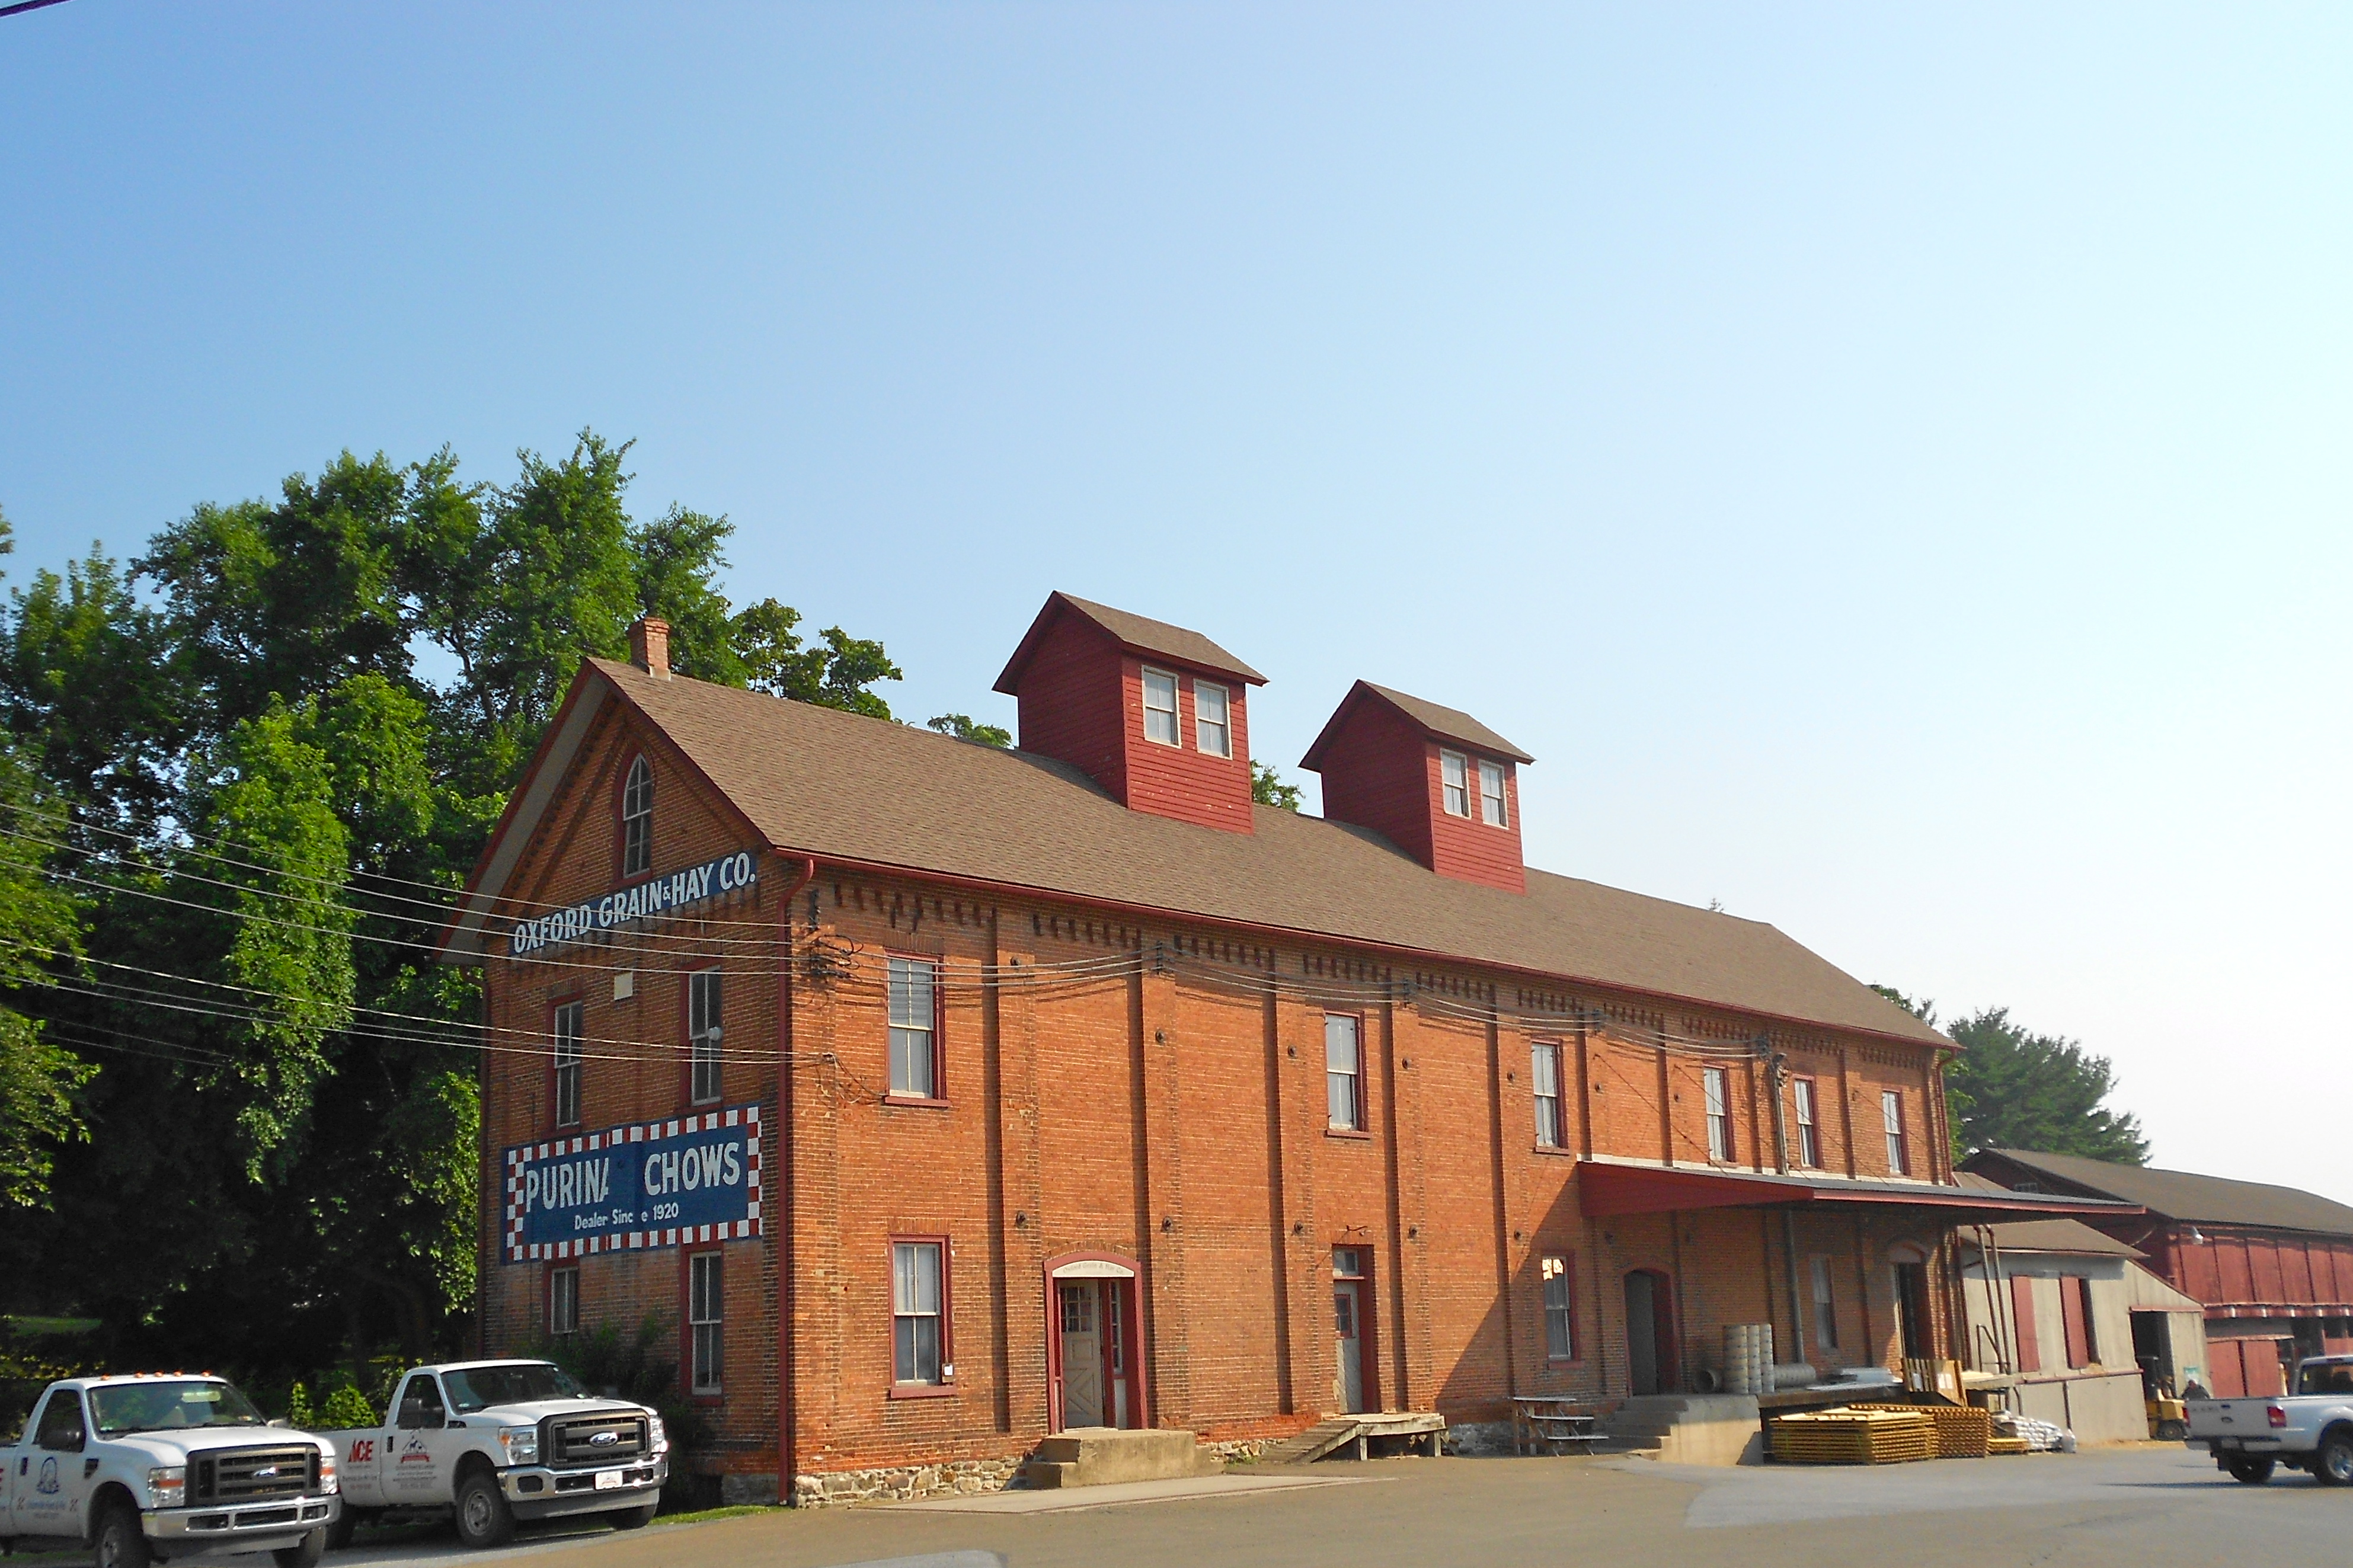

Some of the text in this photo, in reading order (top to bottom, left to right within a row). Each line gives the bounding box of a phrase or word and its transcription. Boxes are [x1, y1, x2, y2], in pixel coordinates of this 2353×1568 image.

[514, 853, 756, 953] OXFORD GRAIN & HAY CO.
[644, 1142, 740, 1196] CHOWS
[574, 1212, 608, 1230] Dealer
[653, 1202, 679, 1221] 1920
[347, 1438, 374, 1463] ACE
